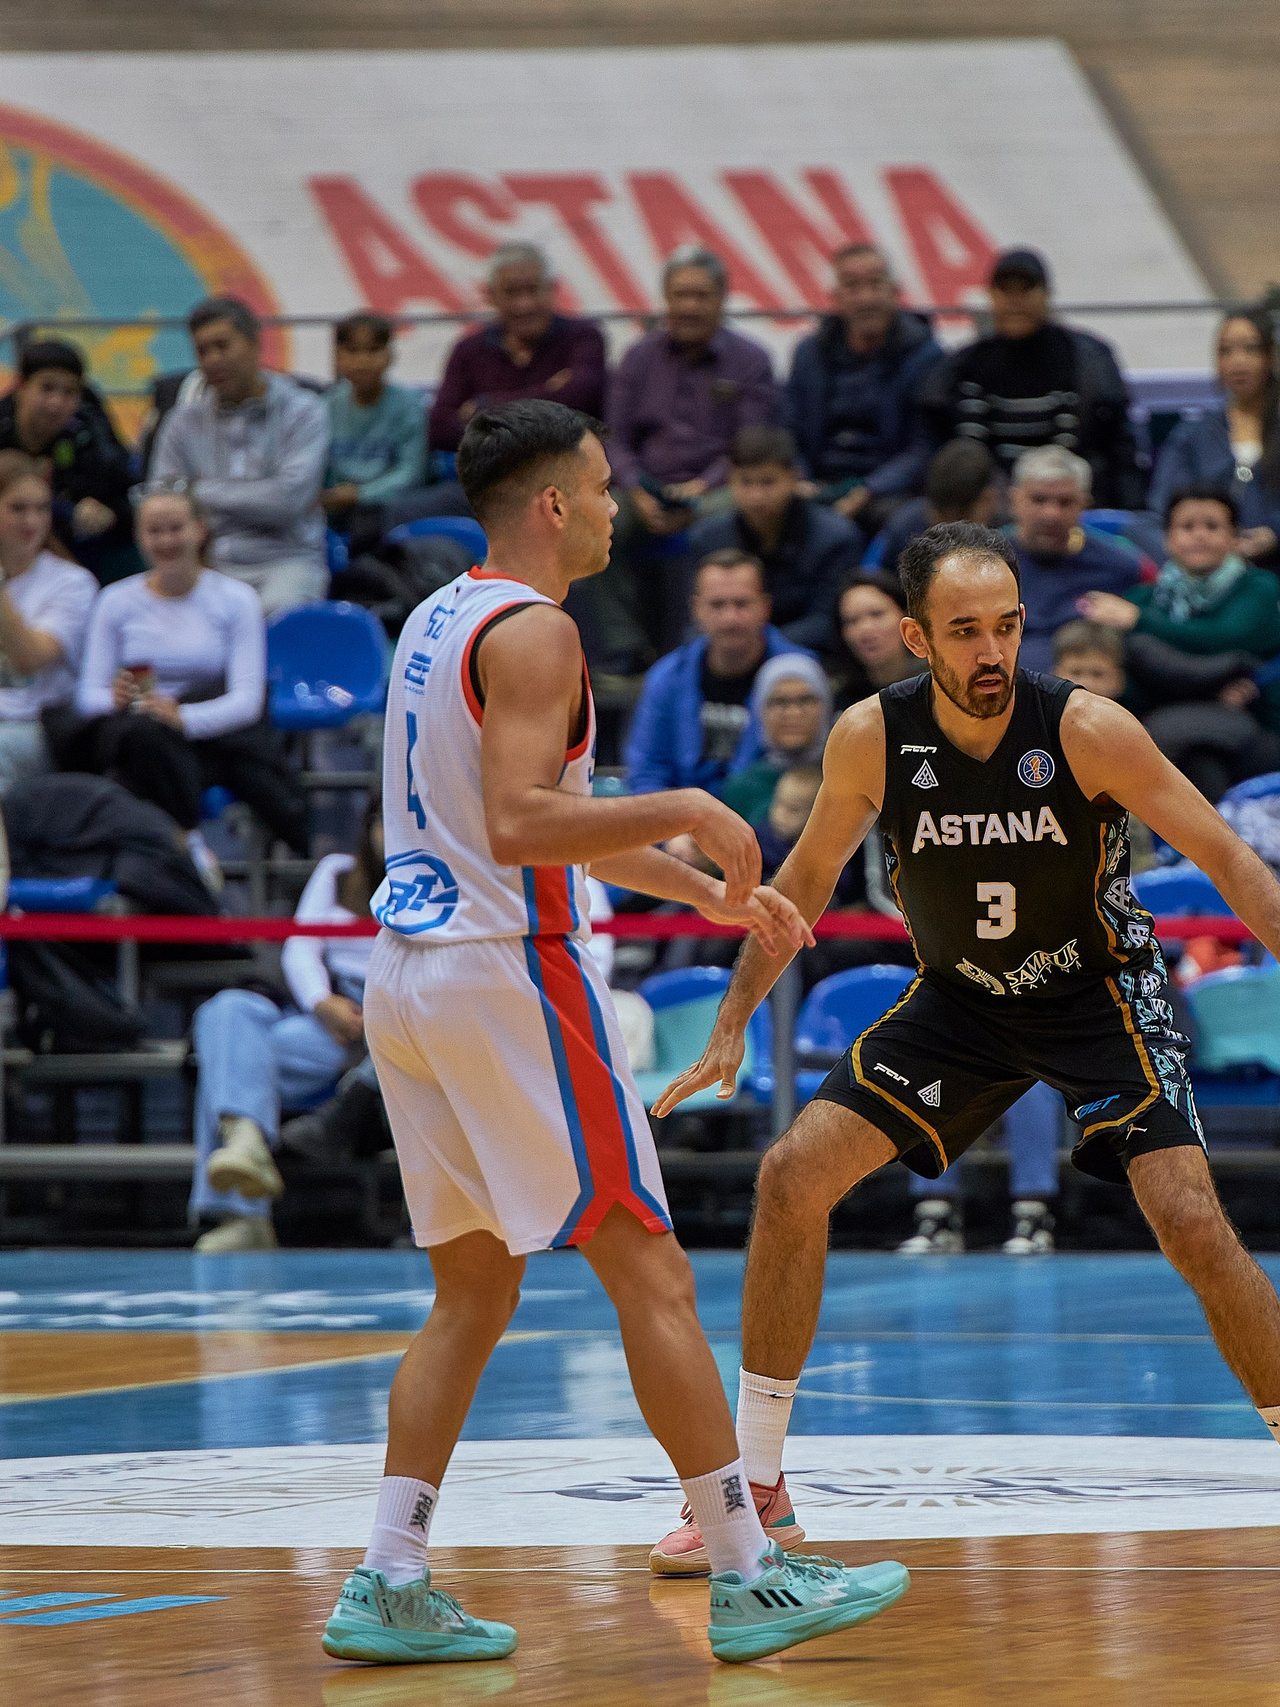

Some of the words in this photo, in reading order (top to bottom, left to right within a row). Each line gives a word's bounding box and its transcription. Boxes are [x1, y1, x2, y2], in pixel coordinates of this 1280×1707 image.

[307, 166, 1000, 330] ASTANA
[911, 806, 1069, 854] ASTANA
[976, 881, 1017, 940] 3
[1004, 940, 1079, 987] SAMRUK
[408, 1491, 434, 1534] PEAK
[721, 1474, 747, 1515] PEAK
